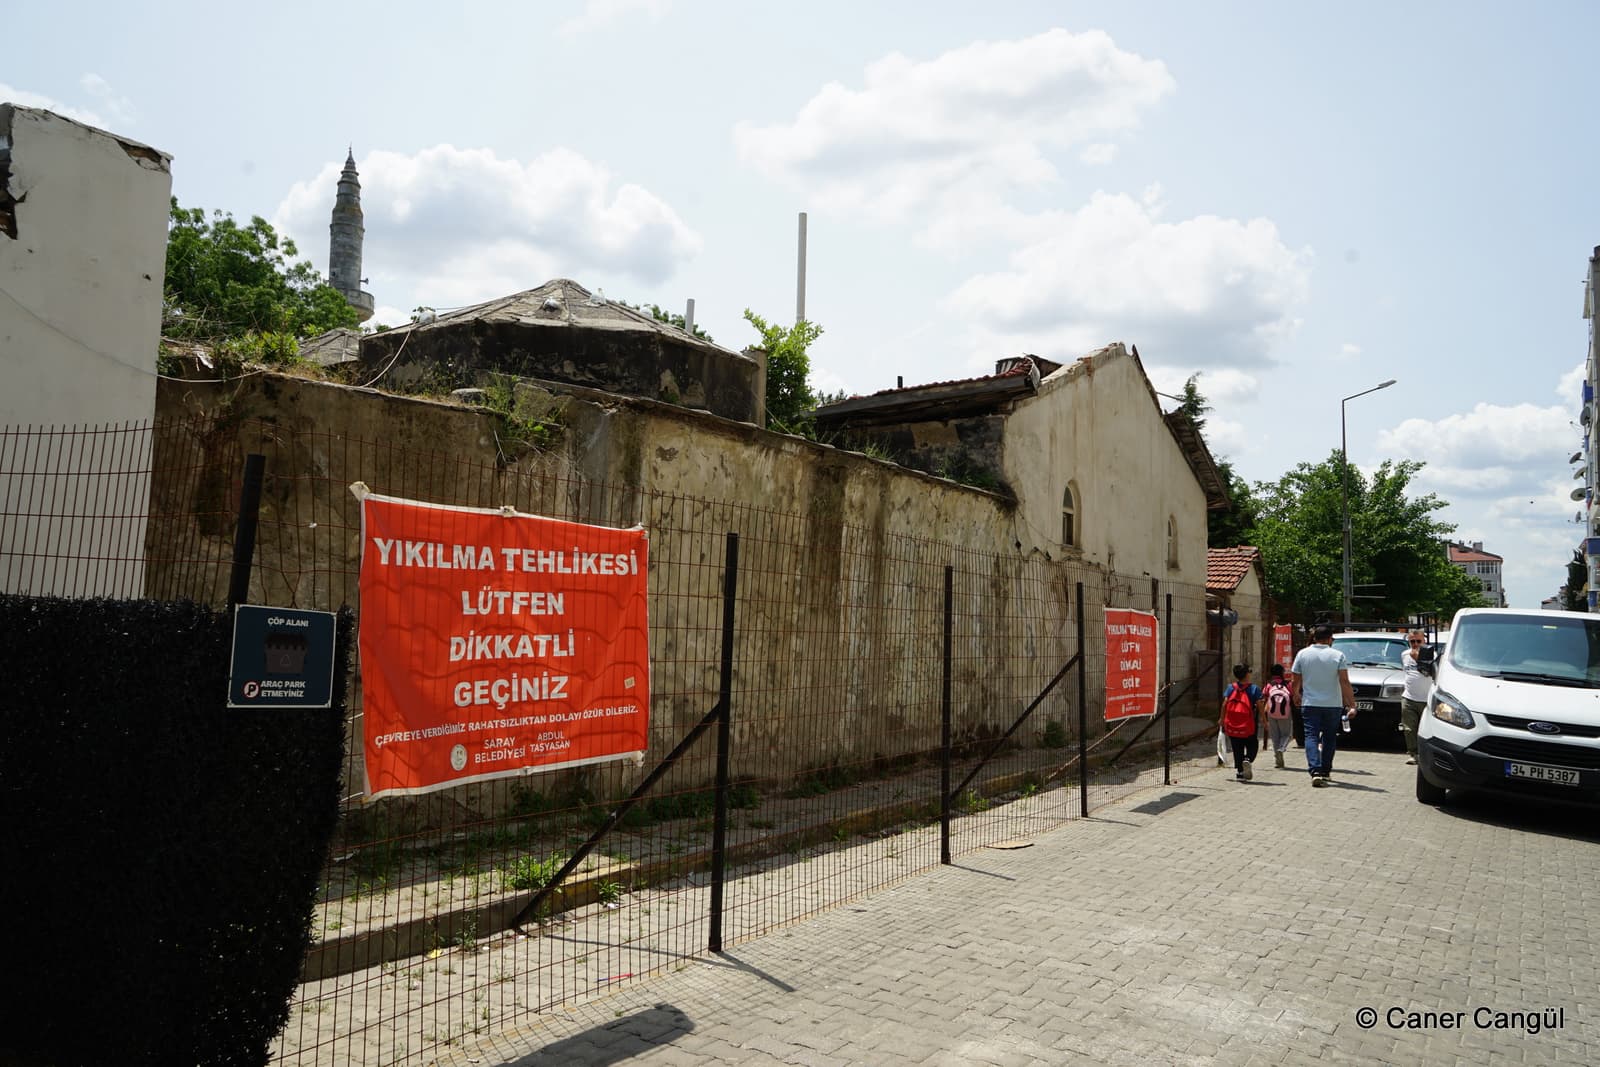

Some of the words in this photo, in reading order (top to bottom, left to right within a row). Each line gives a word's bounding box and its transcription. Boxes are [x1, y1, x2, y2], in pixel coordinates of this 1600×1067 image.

[373, 537, 495, 571] YIKILMA
[501, 546, 638, 576] TEHLİKESİ
[461, 586, 565, 616] LÜTFEN
[267, 616, 285, 627] ÇÖP
[286, 618, 309, 627] ALANI
[450, 628, 575, 662] DİKKATLİ
[260, 680, 284, 689] ARAÇ
[261, 689, 304, 697] ETMEYİNİZ
[453, 671, 569, 710] GEÇİNİZ
[375, 729, 421, 749] ÇEVREYE
[422, 721, 466, 739] VERDİĞİMİZ
[468, 715, 547, 732] RAHATSIZLIKTAN
[549, 711, 582, 723] DOLAYI
[583, 709, 603, 720] ÖZÜR
[605, 705, 638, 717] DİLERİZ.
[537, 731, 565, 741] ABDUL
[484, 736, 516, 749] SARAY
[474, 747, 526, 764] BELEDİYESİ
[1511, 764, 1525, 775] 34
[1530, 767, 1544, 778] PH
[1548, 769, 1576, 783] 5387
